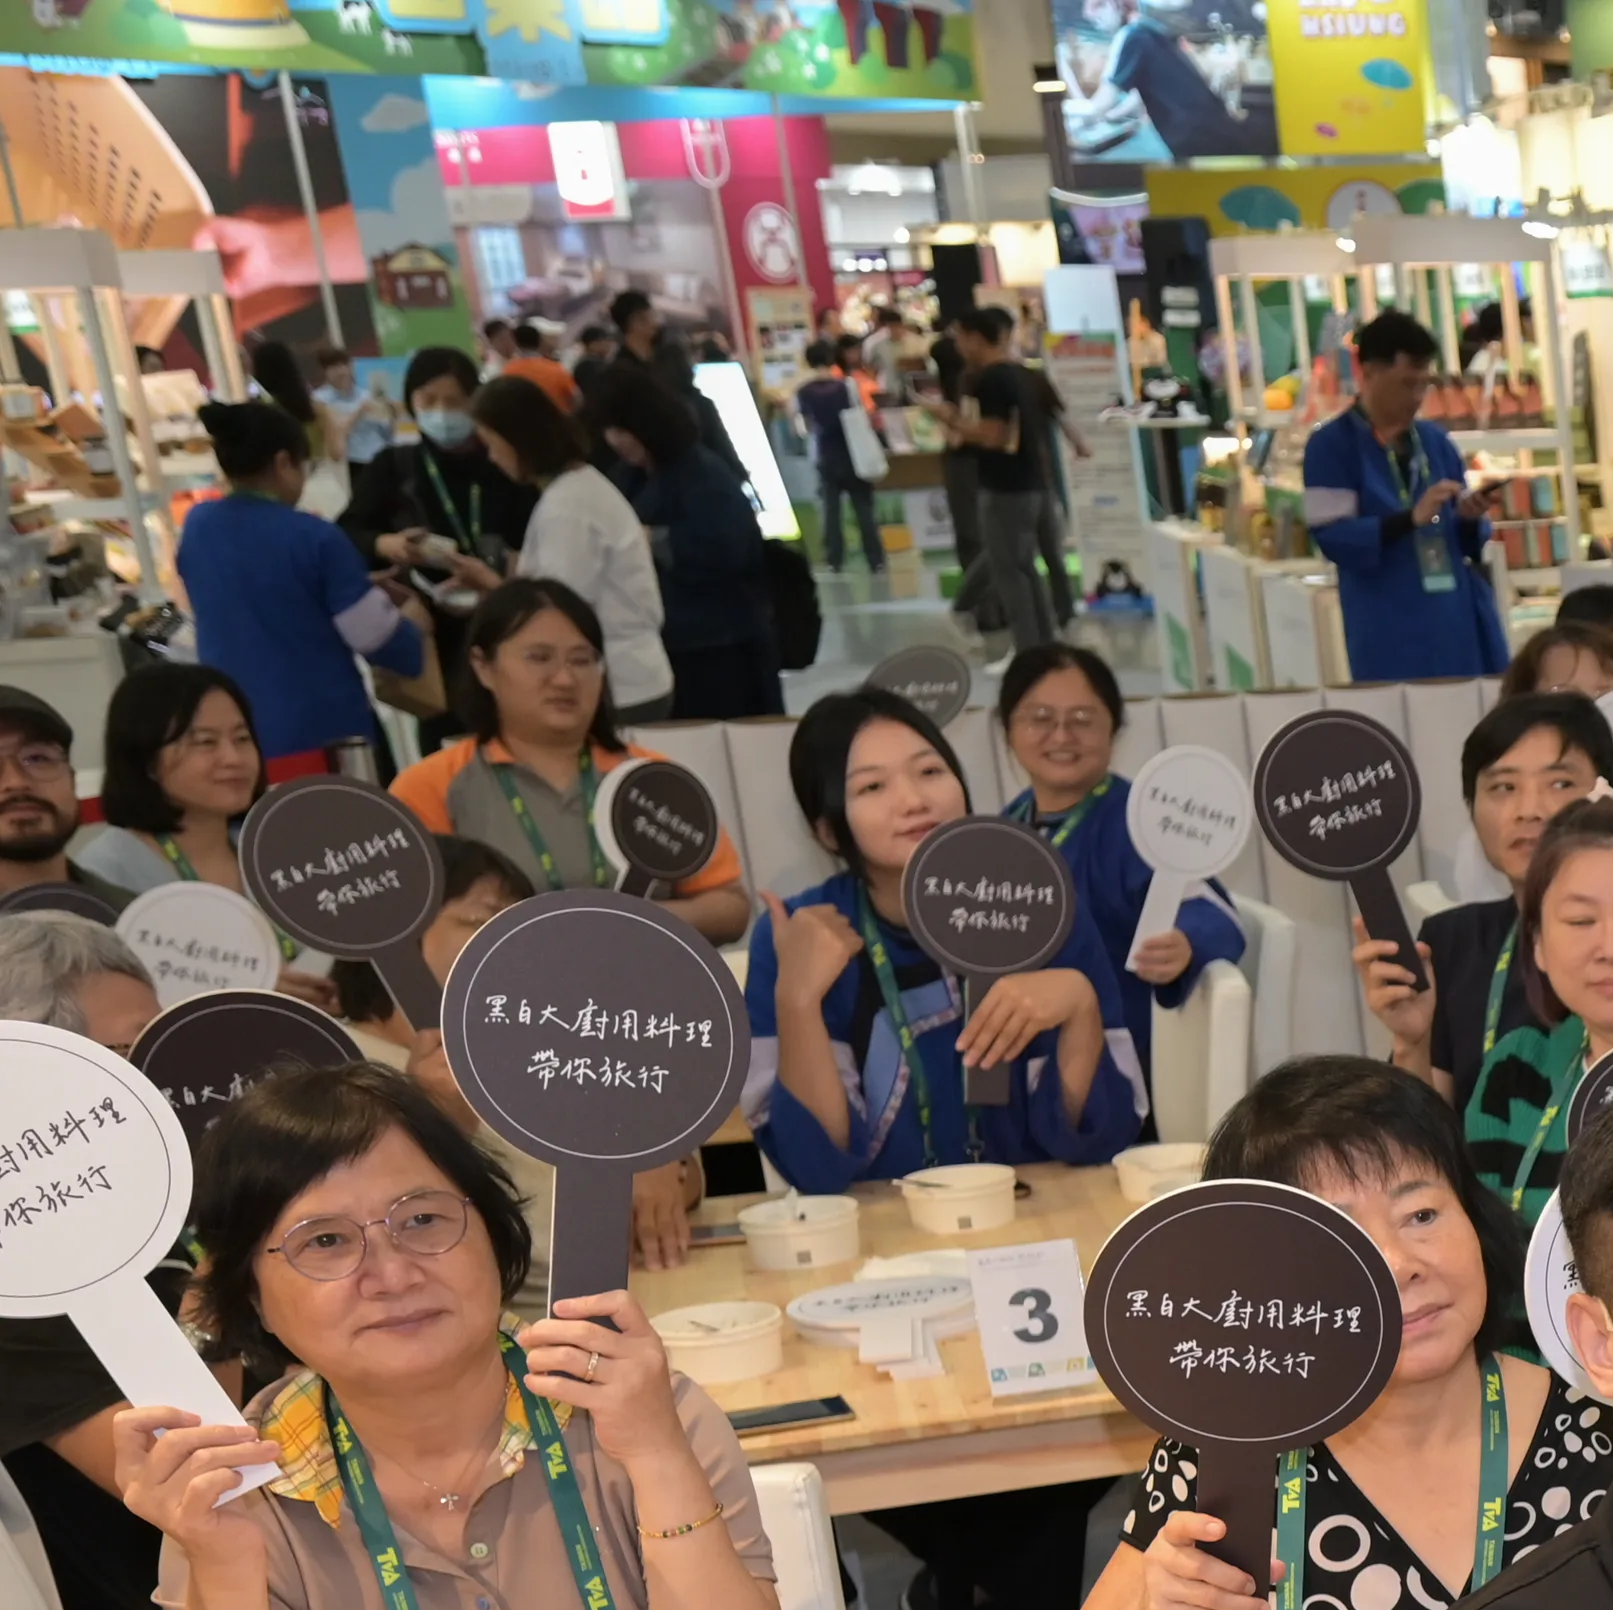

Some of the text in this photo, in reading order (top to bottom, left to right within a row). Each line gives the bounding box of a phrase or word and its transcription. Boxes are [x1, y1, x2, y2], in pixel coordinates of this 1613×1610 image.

[0, 1163, 114, 1252] 你旅行
[1008, 1286, 1060, 1345] 3
